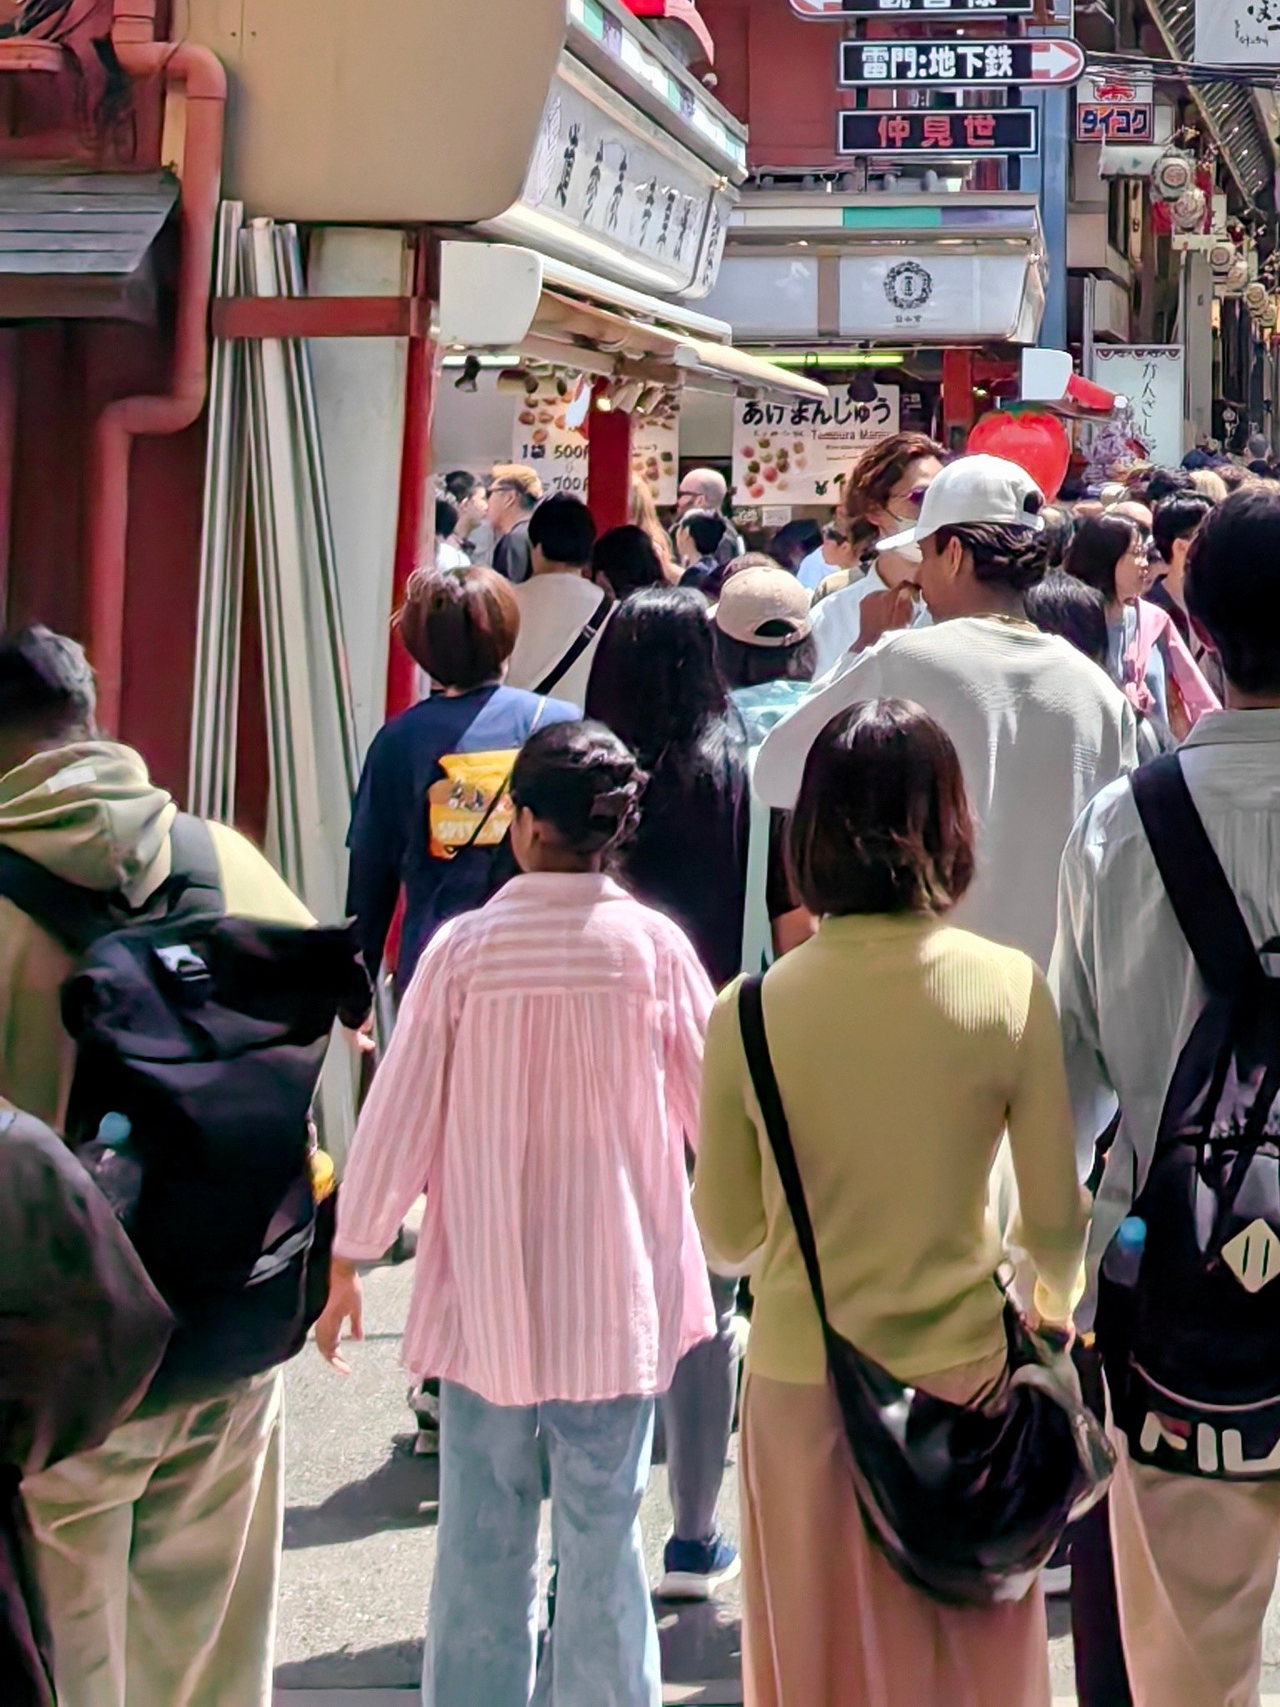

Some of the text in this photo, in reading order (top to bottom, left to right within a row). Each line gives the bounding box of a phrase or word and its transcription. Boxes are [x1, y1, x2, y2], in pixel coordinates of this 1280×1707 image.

[862, 45, 1013, 79] 雷門:地下鉄
[878, 114, 996, 148] 仲見世
[1082, 106, 1148, 136] ダイコク
